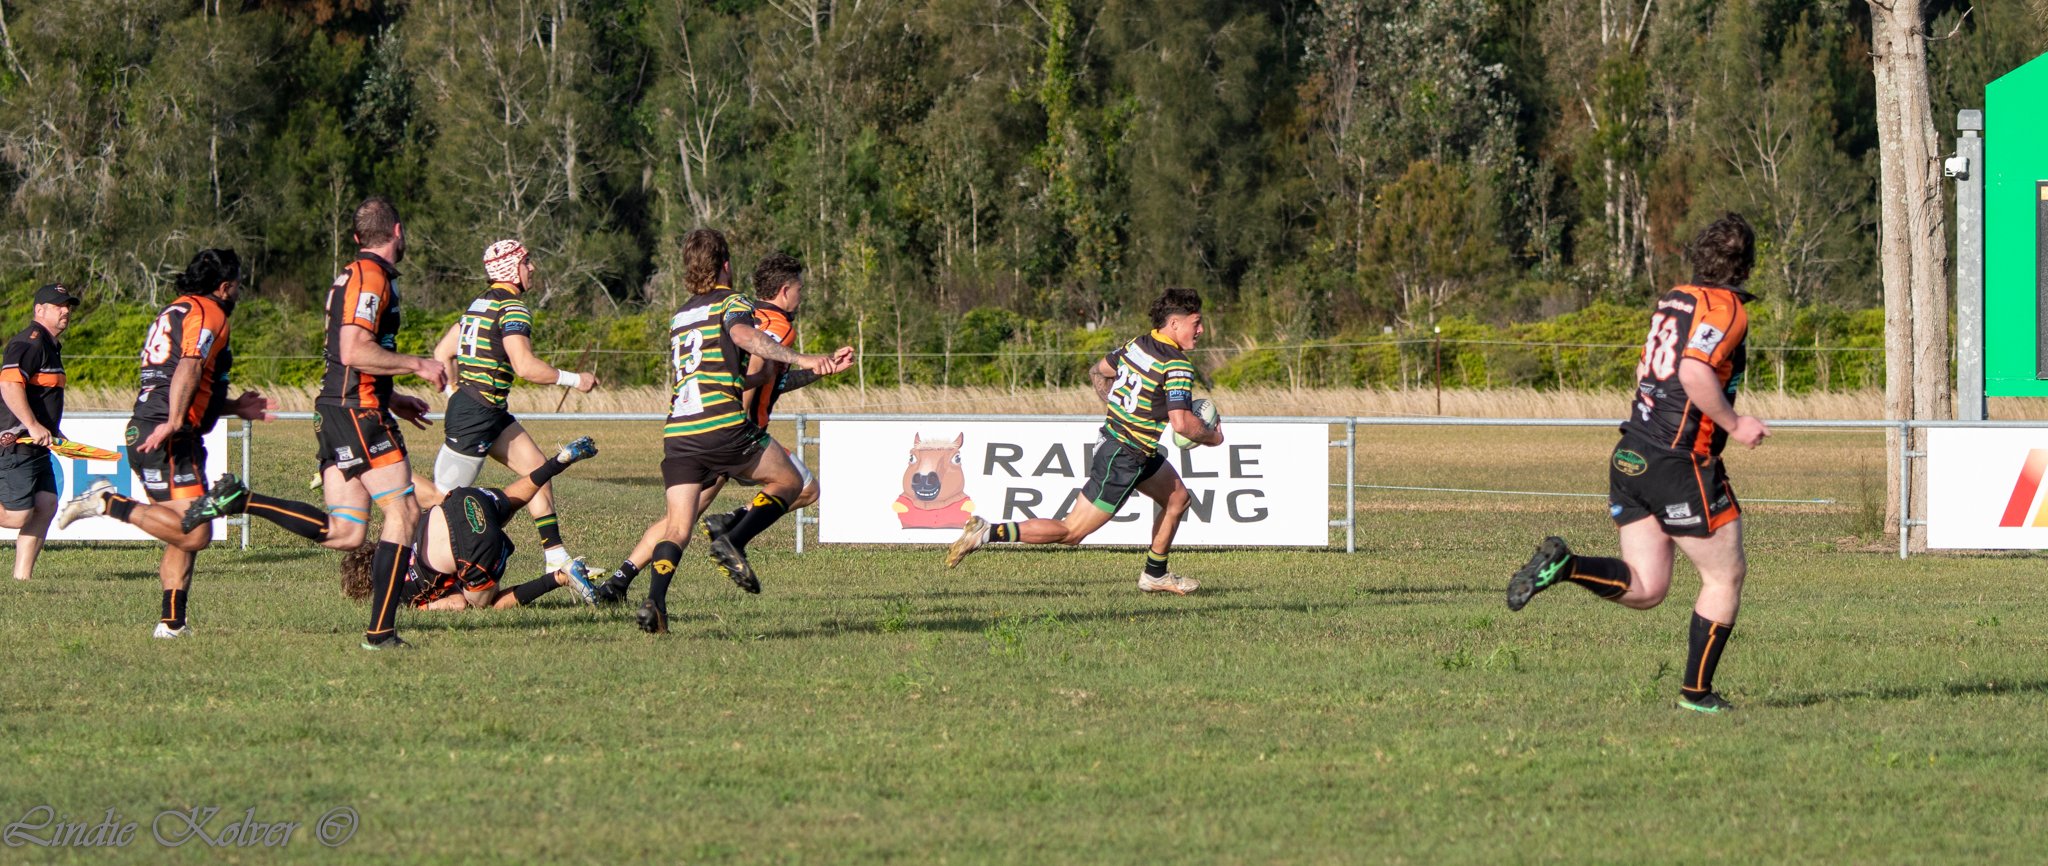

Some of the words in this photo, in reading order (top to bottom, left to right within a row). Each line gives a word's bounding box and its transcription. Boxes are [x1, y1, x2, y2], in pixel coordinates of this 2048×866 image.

[457, 316, 480, 358] 14
[671, 329, 703, 381] 13
[1108, 364, 1142, 413] 23
[51, 446, 131, 501] H
[983, 442, 1263, 478] RALE
[1002, 487, 1268, 523] RANG
